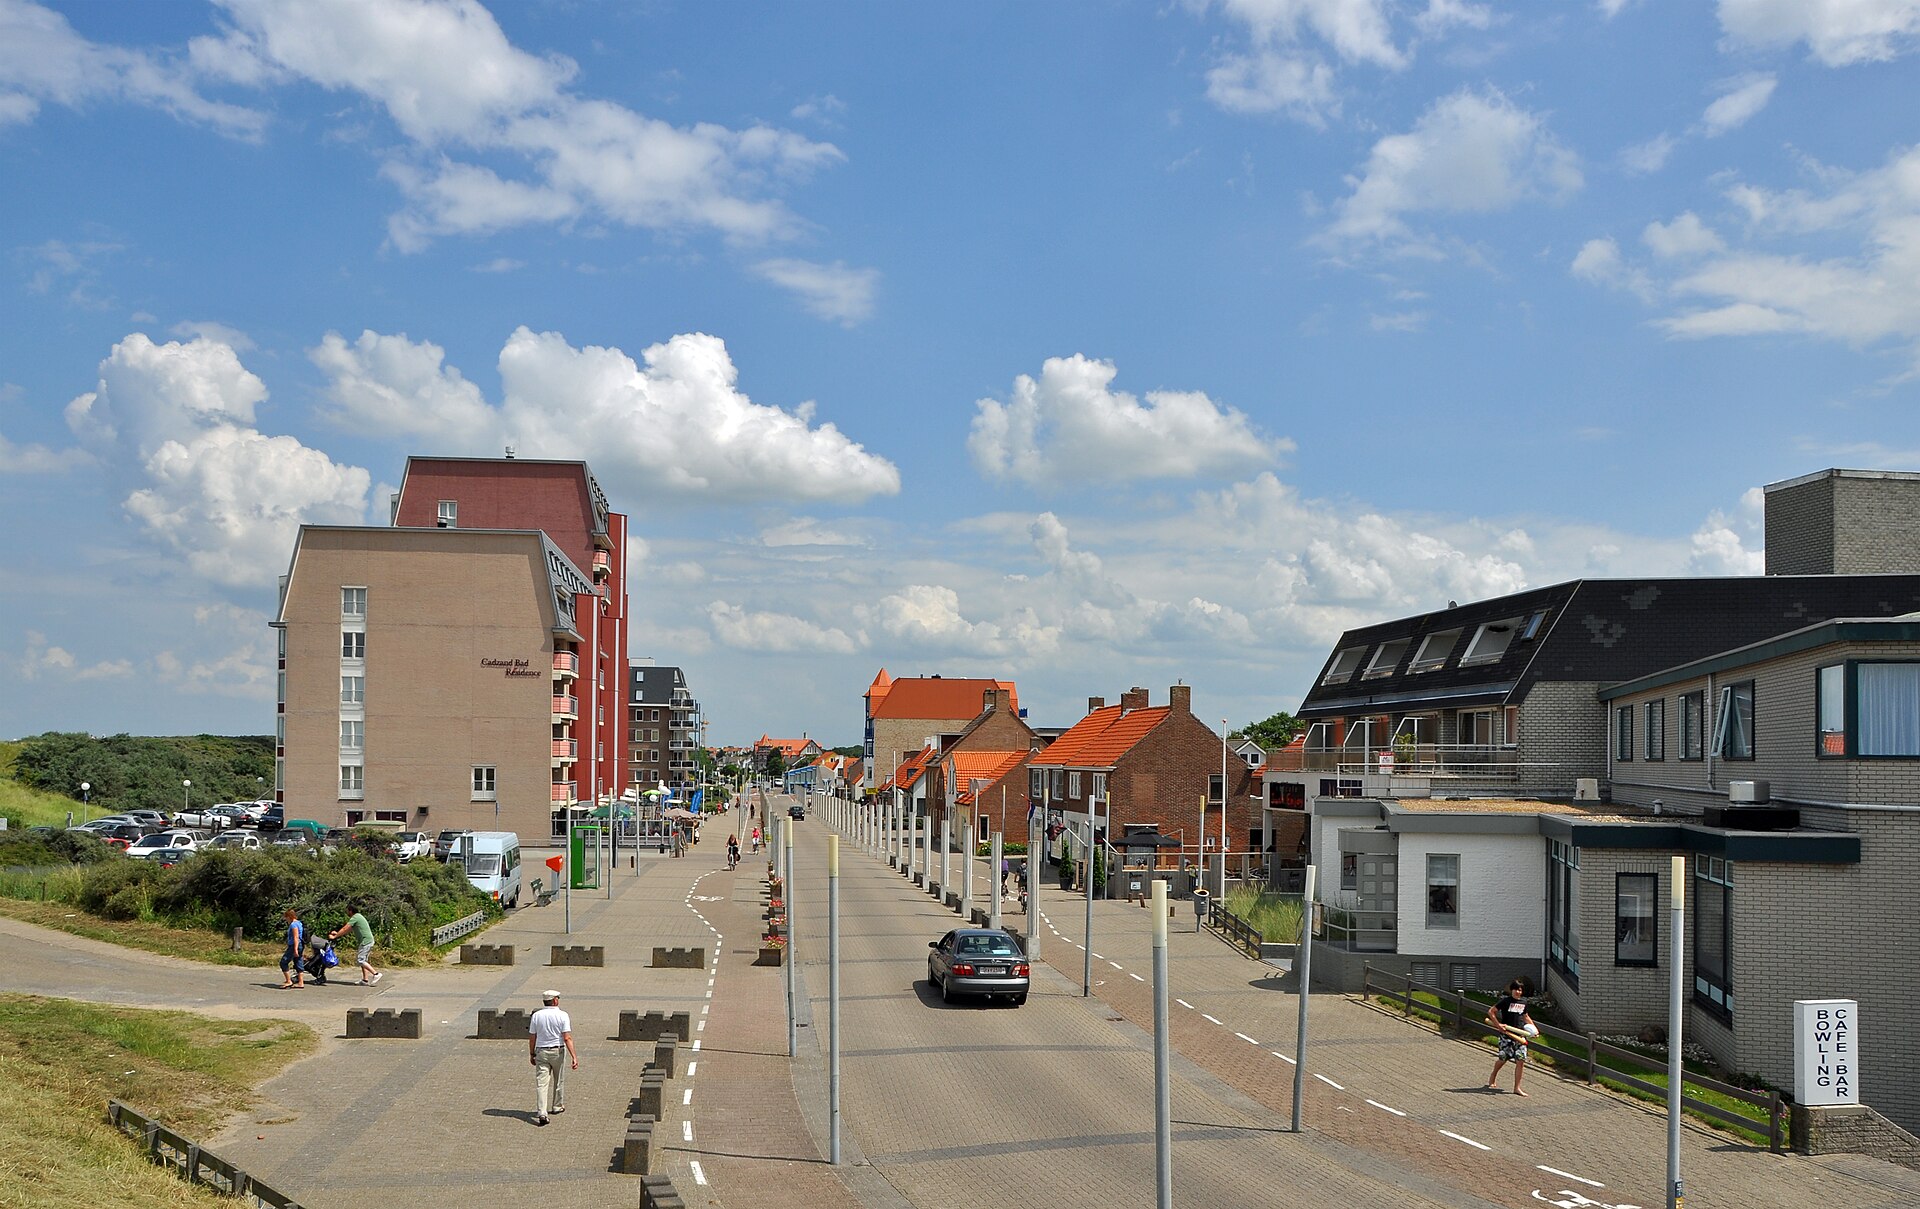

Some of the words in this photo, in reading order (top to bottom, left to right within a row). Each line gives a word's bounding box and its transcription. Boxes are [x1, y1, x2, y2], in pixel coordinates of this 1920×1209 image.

[481, 658, 513, 666] Cadzand
[1814, 1010, 1832, 1087] BOWLING
[1835, 1009, 1848, 1097] CAFE-BAR
